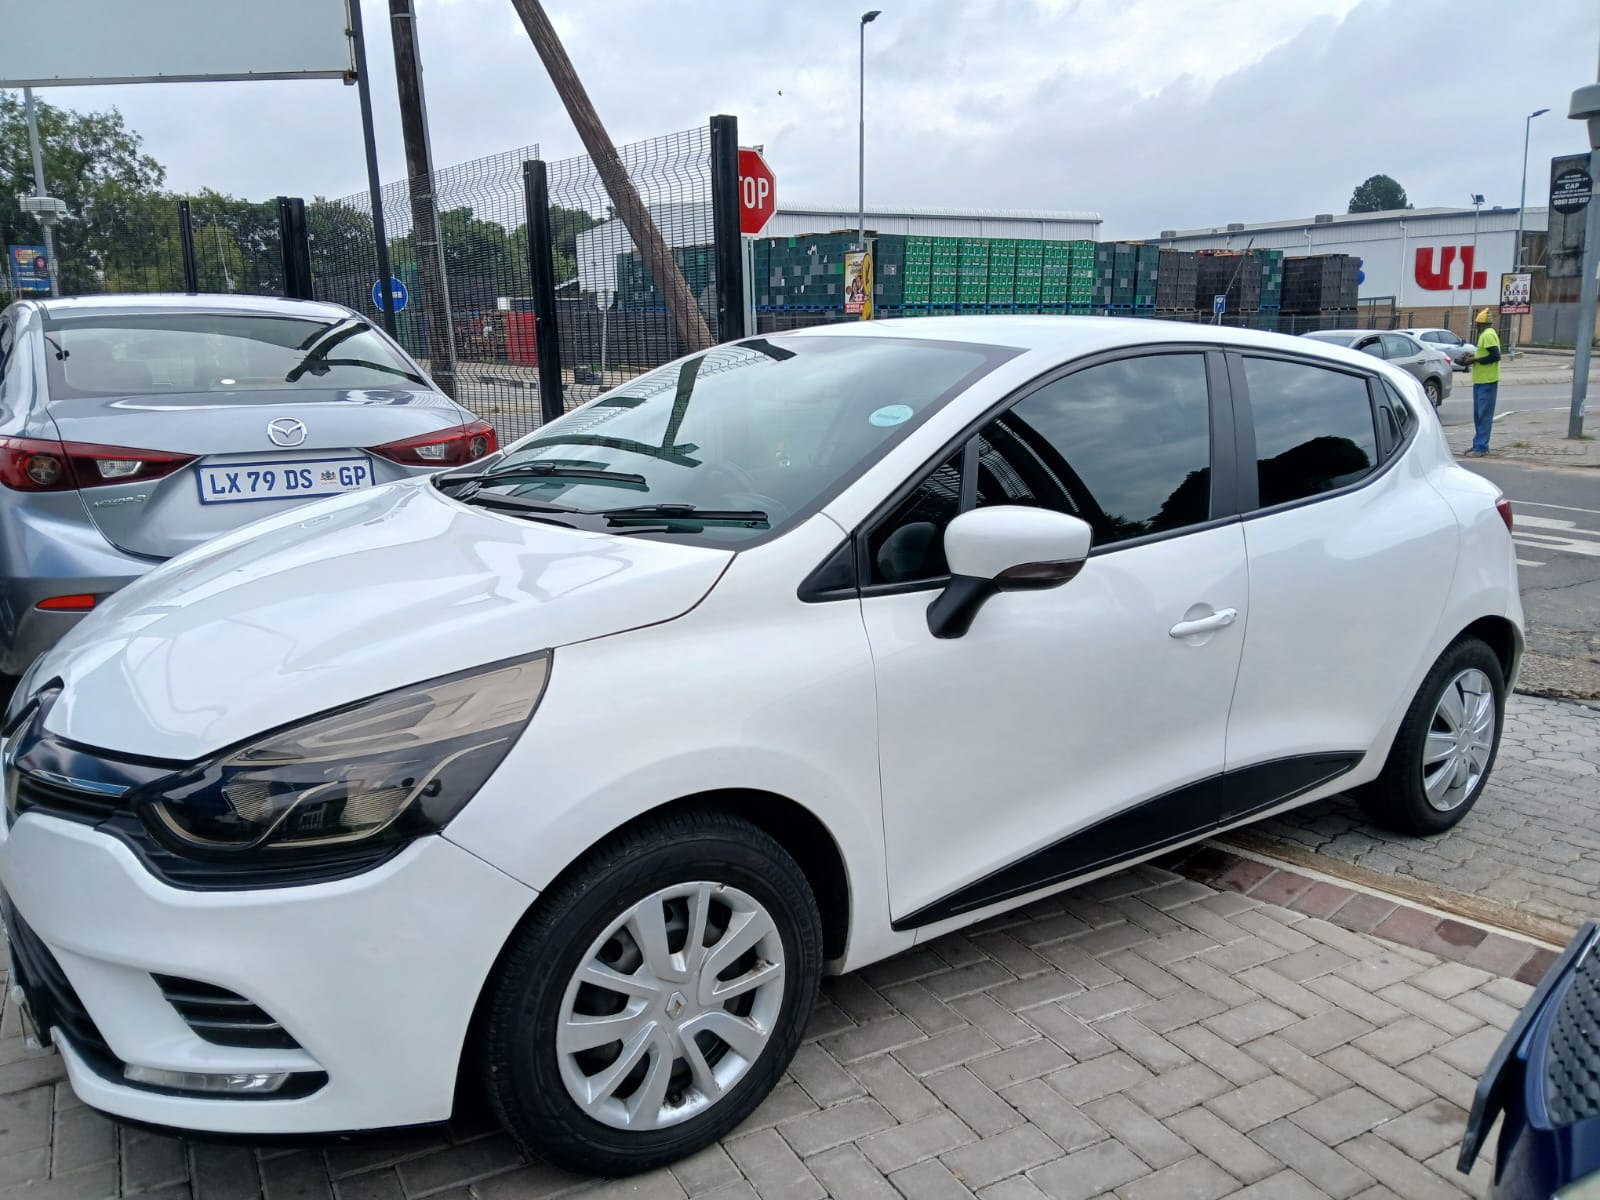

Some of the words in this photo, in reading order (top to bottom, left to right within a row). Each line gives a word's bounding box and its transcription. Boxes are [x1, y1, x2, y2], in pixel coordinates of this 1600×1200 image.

[210, 472, 241, 495] LX
[247, 470, 276, 492] 79
[284, 468, 313, 490] DS
[339, 465, 366, 487] GP
